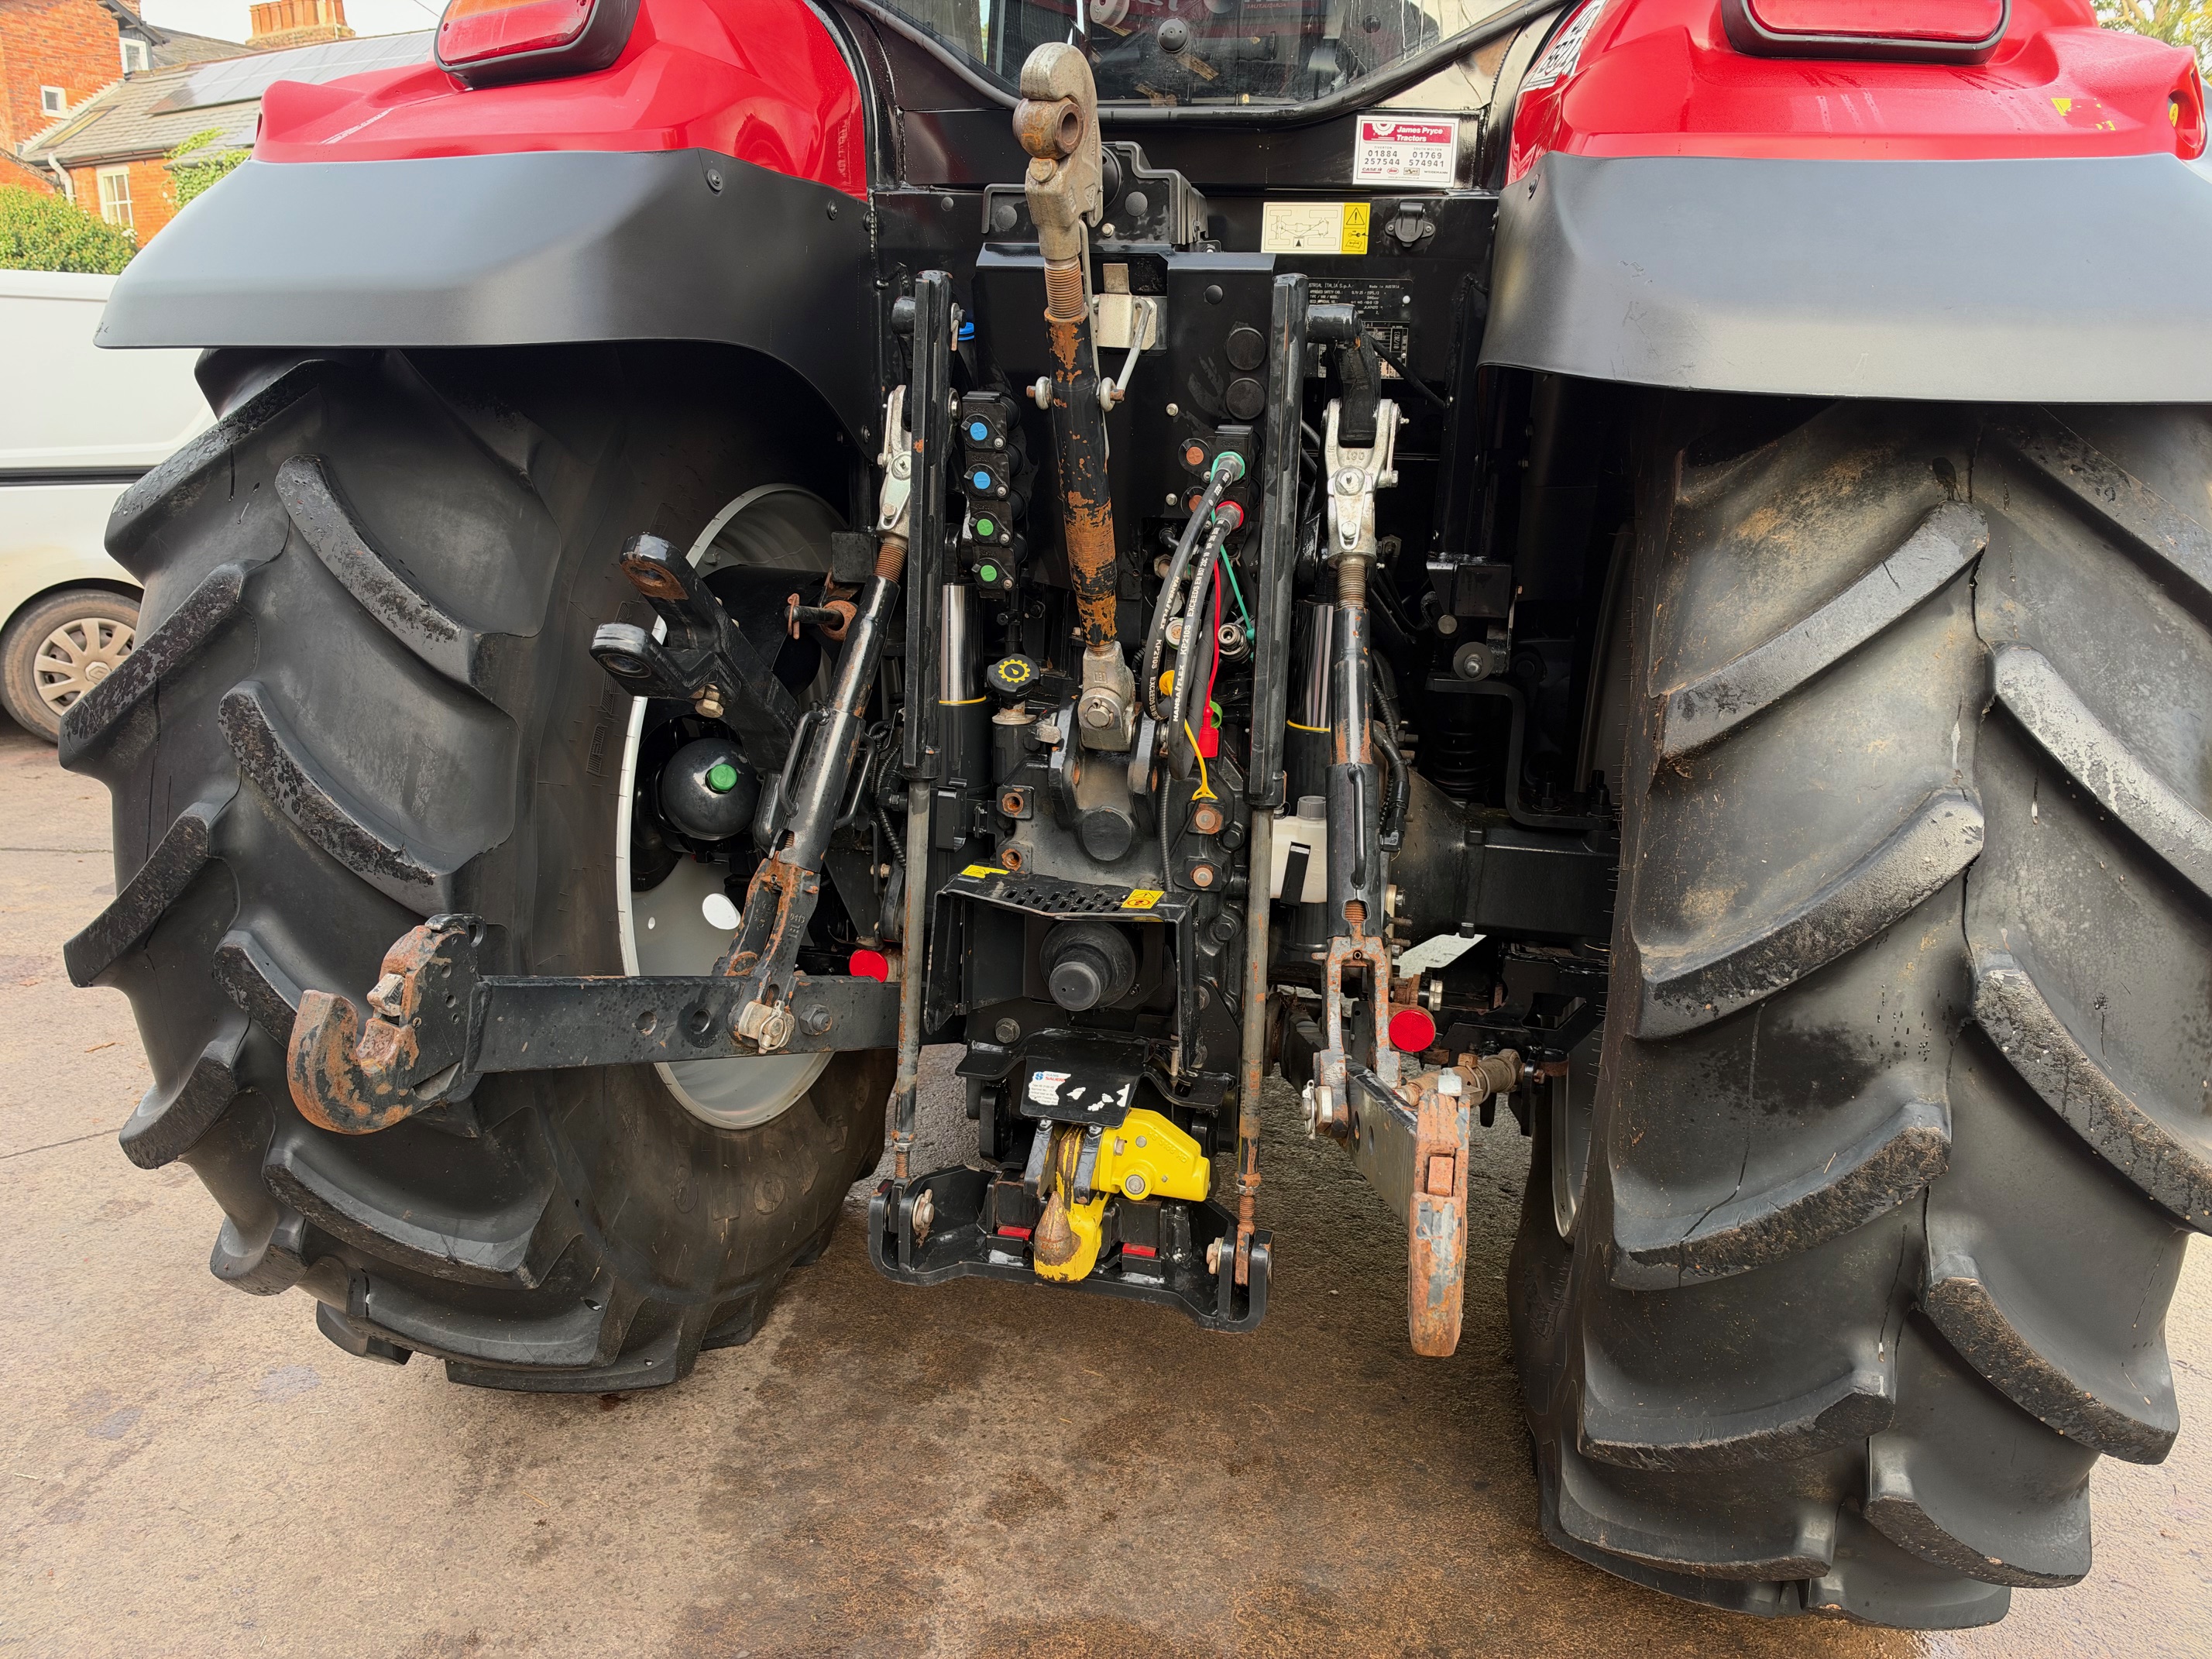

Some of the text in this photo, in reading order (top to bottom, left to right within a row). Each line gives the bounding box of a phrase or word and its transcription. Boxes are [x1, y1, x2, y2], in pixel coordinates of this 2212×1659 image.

[1422, 127, 1444, 136] Pryce
[1180, 624, 1191, 655] KP210S
[1187, 585, 1200, 617] EXCEEDS
[1151, 639, 1163, 670] KP210S
